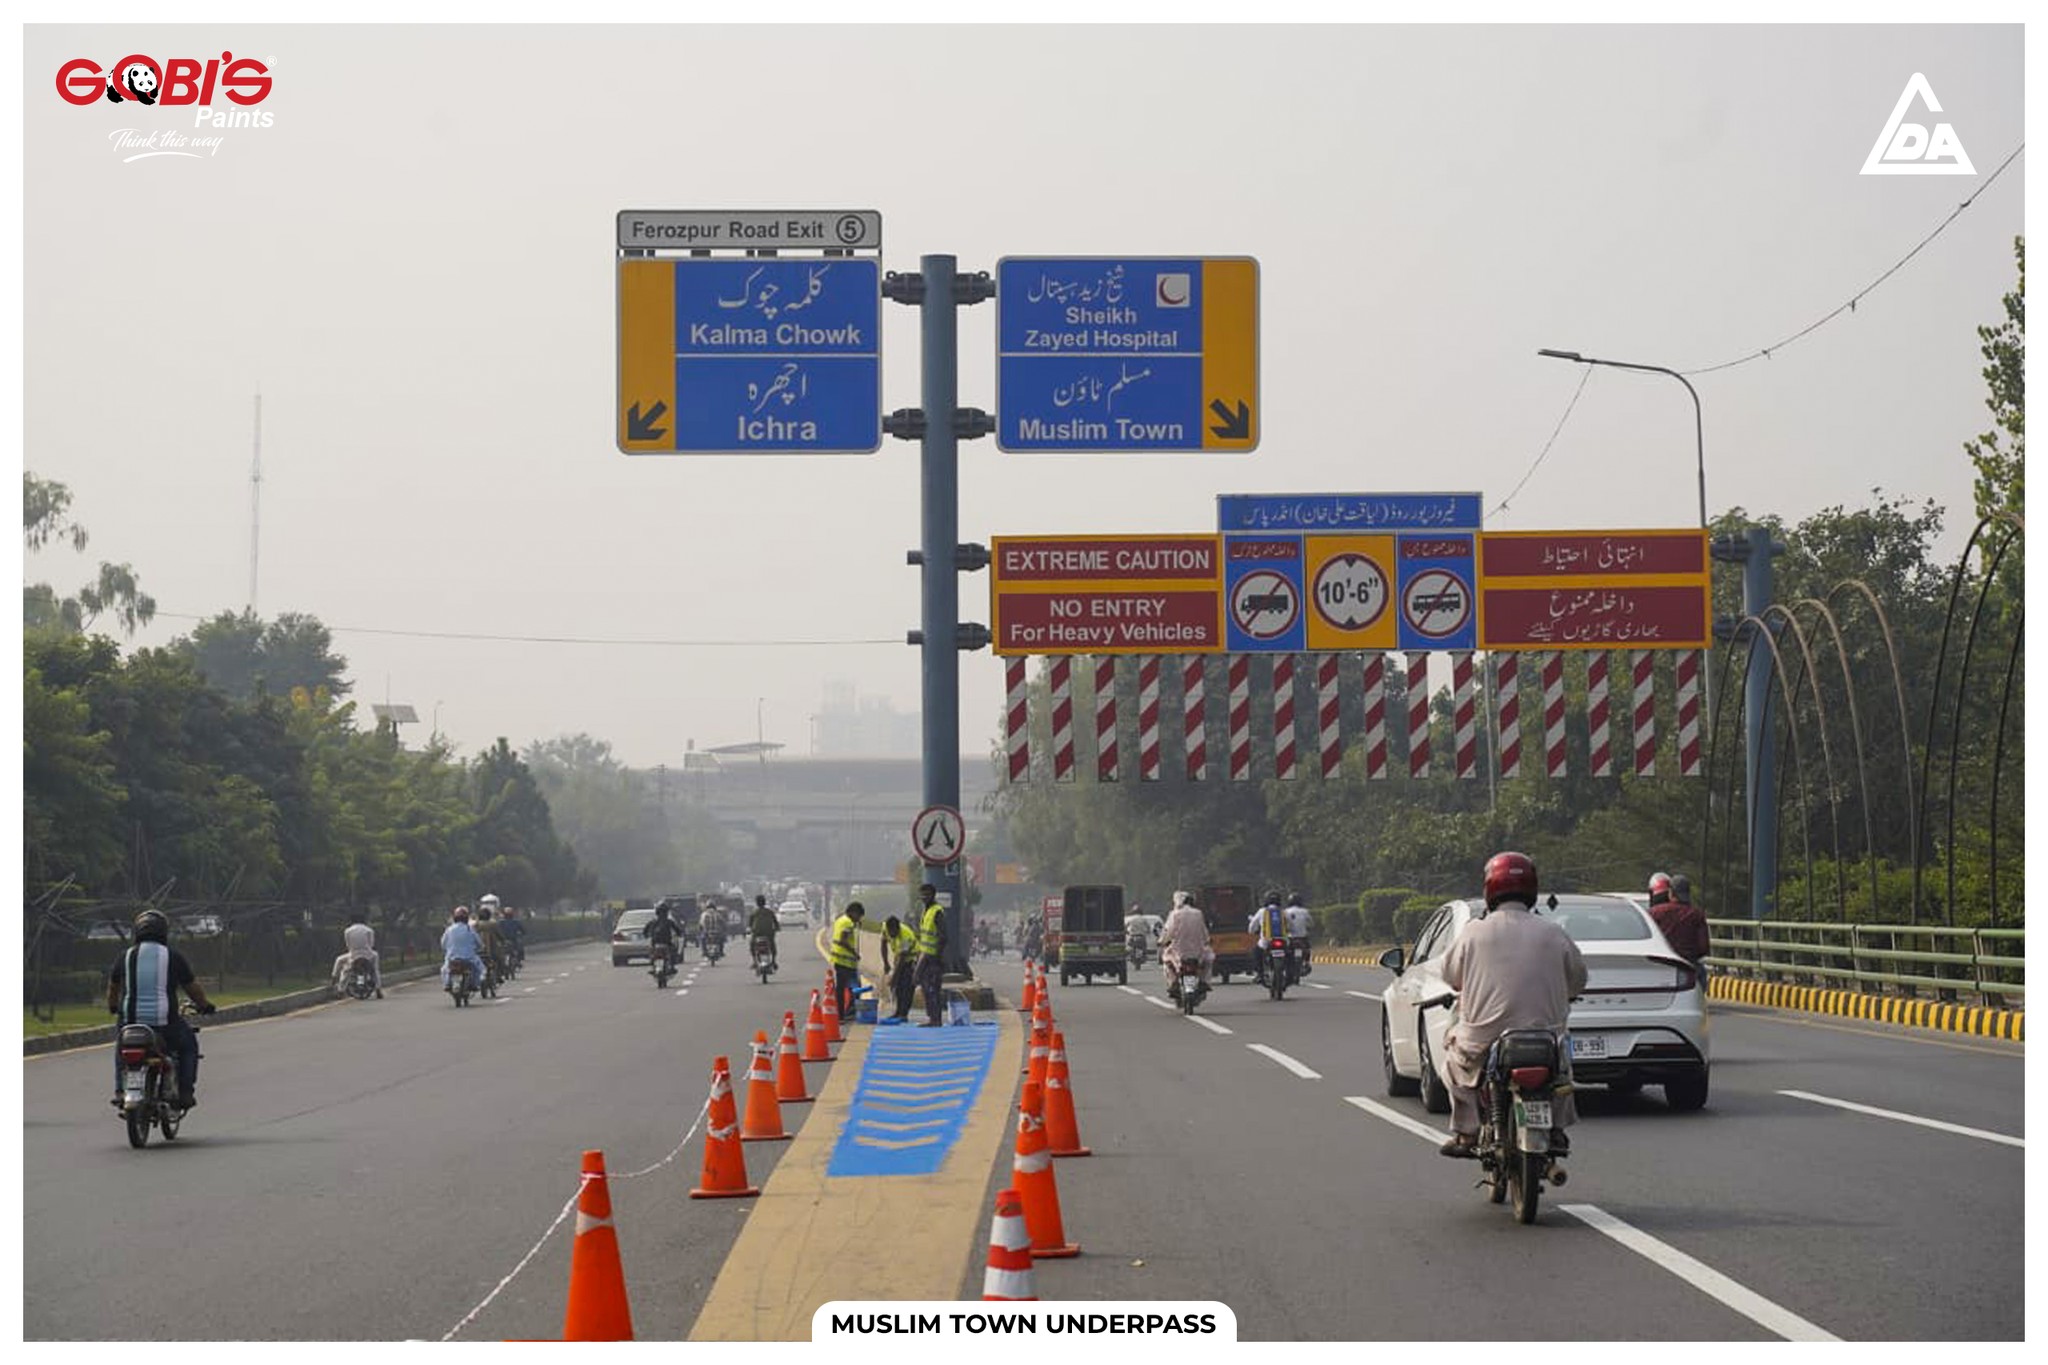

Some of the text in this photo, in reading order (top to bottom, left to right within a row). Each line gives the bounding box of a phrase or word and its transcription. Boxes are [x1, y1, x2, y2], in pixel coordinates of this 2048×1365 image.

[632, 221, 858, 243] Ferozpur Road Exit 5
[718, 263, 832, 320] کلمہ چوک
[1105, 264, 1125, 303] شیخ
[1065, 306, 1138, 325] Sheikh
[690, 323, 861, 345] Kalma Chowk
[1024, 330, 1178, 351] Zayed Hospital
[748, 363, 808, 415] اچھرہ
[1107, 361, 1151, 414] مسلم
[737, 415, 817, 441] Ichra
[1018, 418, 1184, 441] Muslim Town
[1005, 549, 1210, 571] EXTREME CAUTION
[1542, 546, 1589, 570] احتیاط
[1049, 598, 1167, 617] NO ENTRY
[1550, 591, 1635, 617] داخلہ ممنوع
[1010, 622, 1207, 644] For Heavy Vehicles
